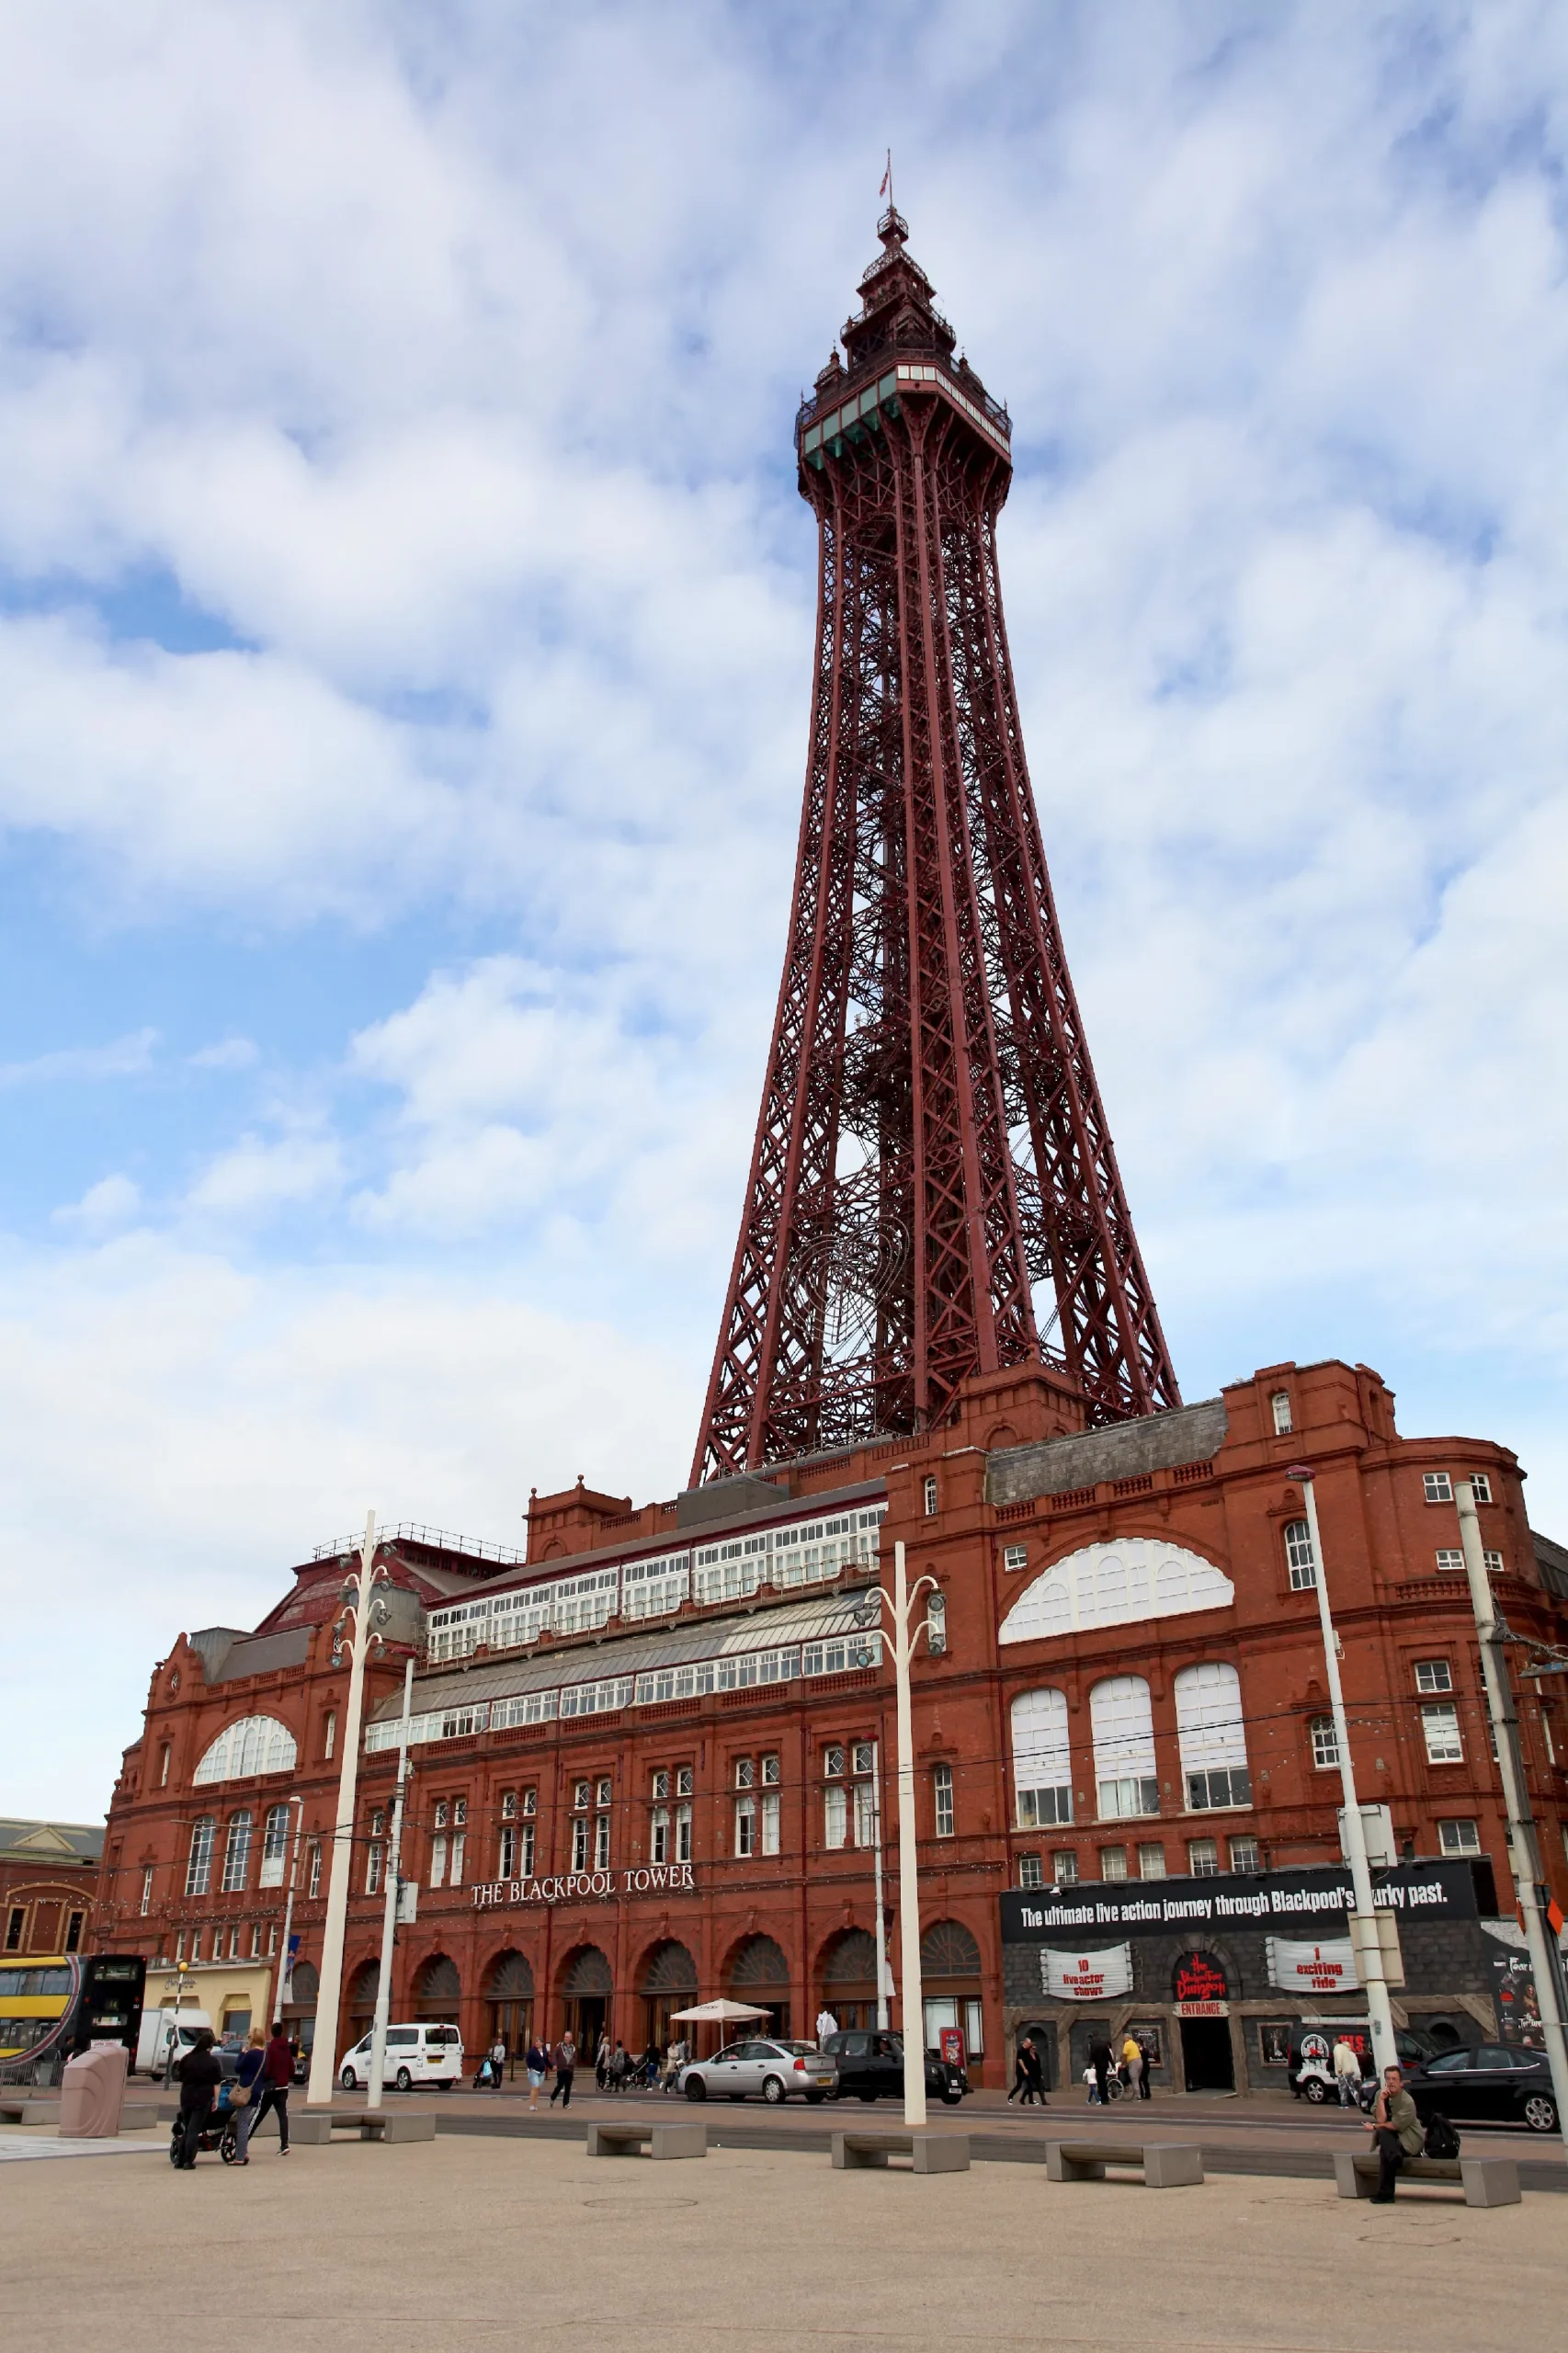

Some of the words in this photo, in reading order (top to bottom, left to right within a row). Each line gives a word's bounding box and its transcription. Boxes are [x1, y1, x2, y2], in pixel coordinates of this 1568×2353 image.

[471, 1883, 504, 1905] THE
[509, 1871, 616, 1903] BLACKPOOL
[623, 1864, 695, 1892] TOWER
[1021, 1907, 1042, 1927] The
[1044, 1904, 1095, 1926] ultimate
[1096, 1903, 1119, 1923] live
[1121, 1899, 1161, 1921] action
[1163, 1898, 1211, 1921] journey
[1215, 1892, 1270, 1916] through
[1271, 1886, 1355, 1913] Blackpool's
[1407, 1881, 1448, 1907] past.
[1313, 1947, 1320, 1961] 1
[1078, 1959, 1089, 1972] 10
[1296, 1962, 1343, 1976] exciting
[1062, 1973, 1078, 1984] live
[1078, 1973, 1105, 1985] actor
[1312, 1976, 1336, 1988] ride
[1074, 1985, 1104, 1996] shows
[1181, 2002, 1221, 2016] ENTRANCE
